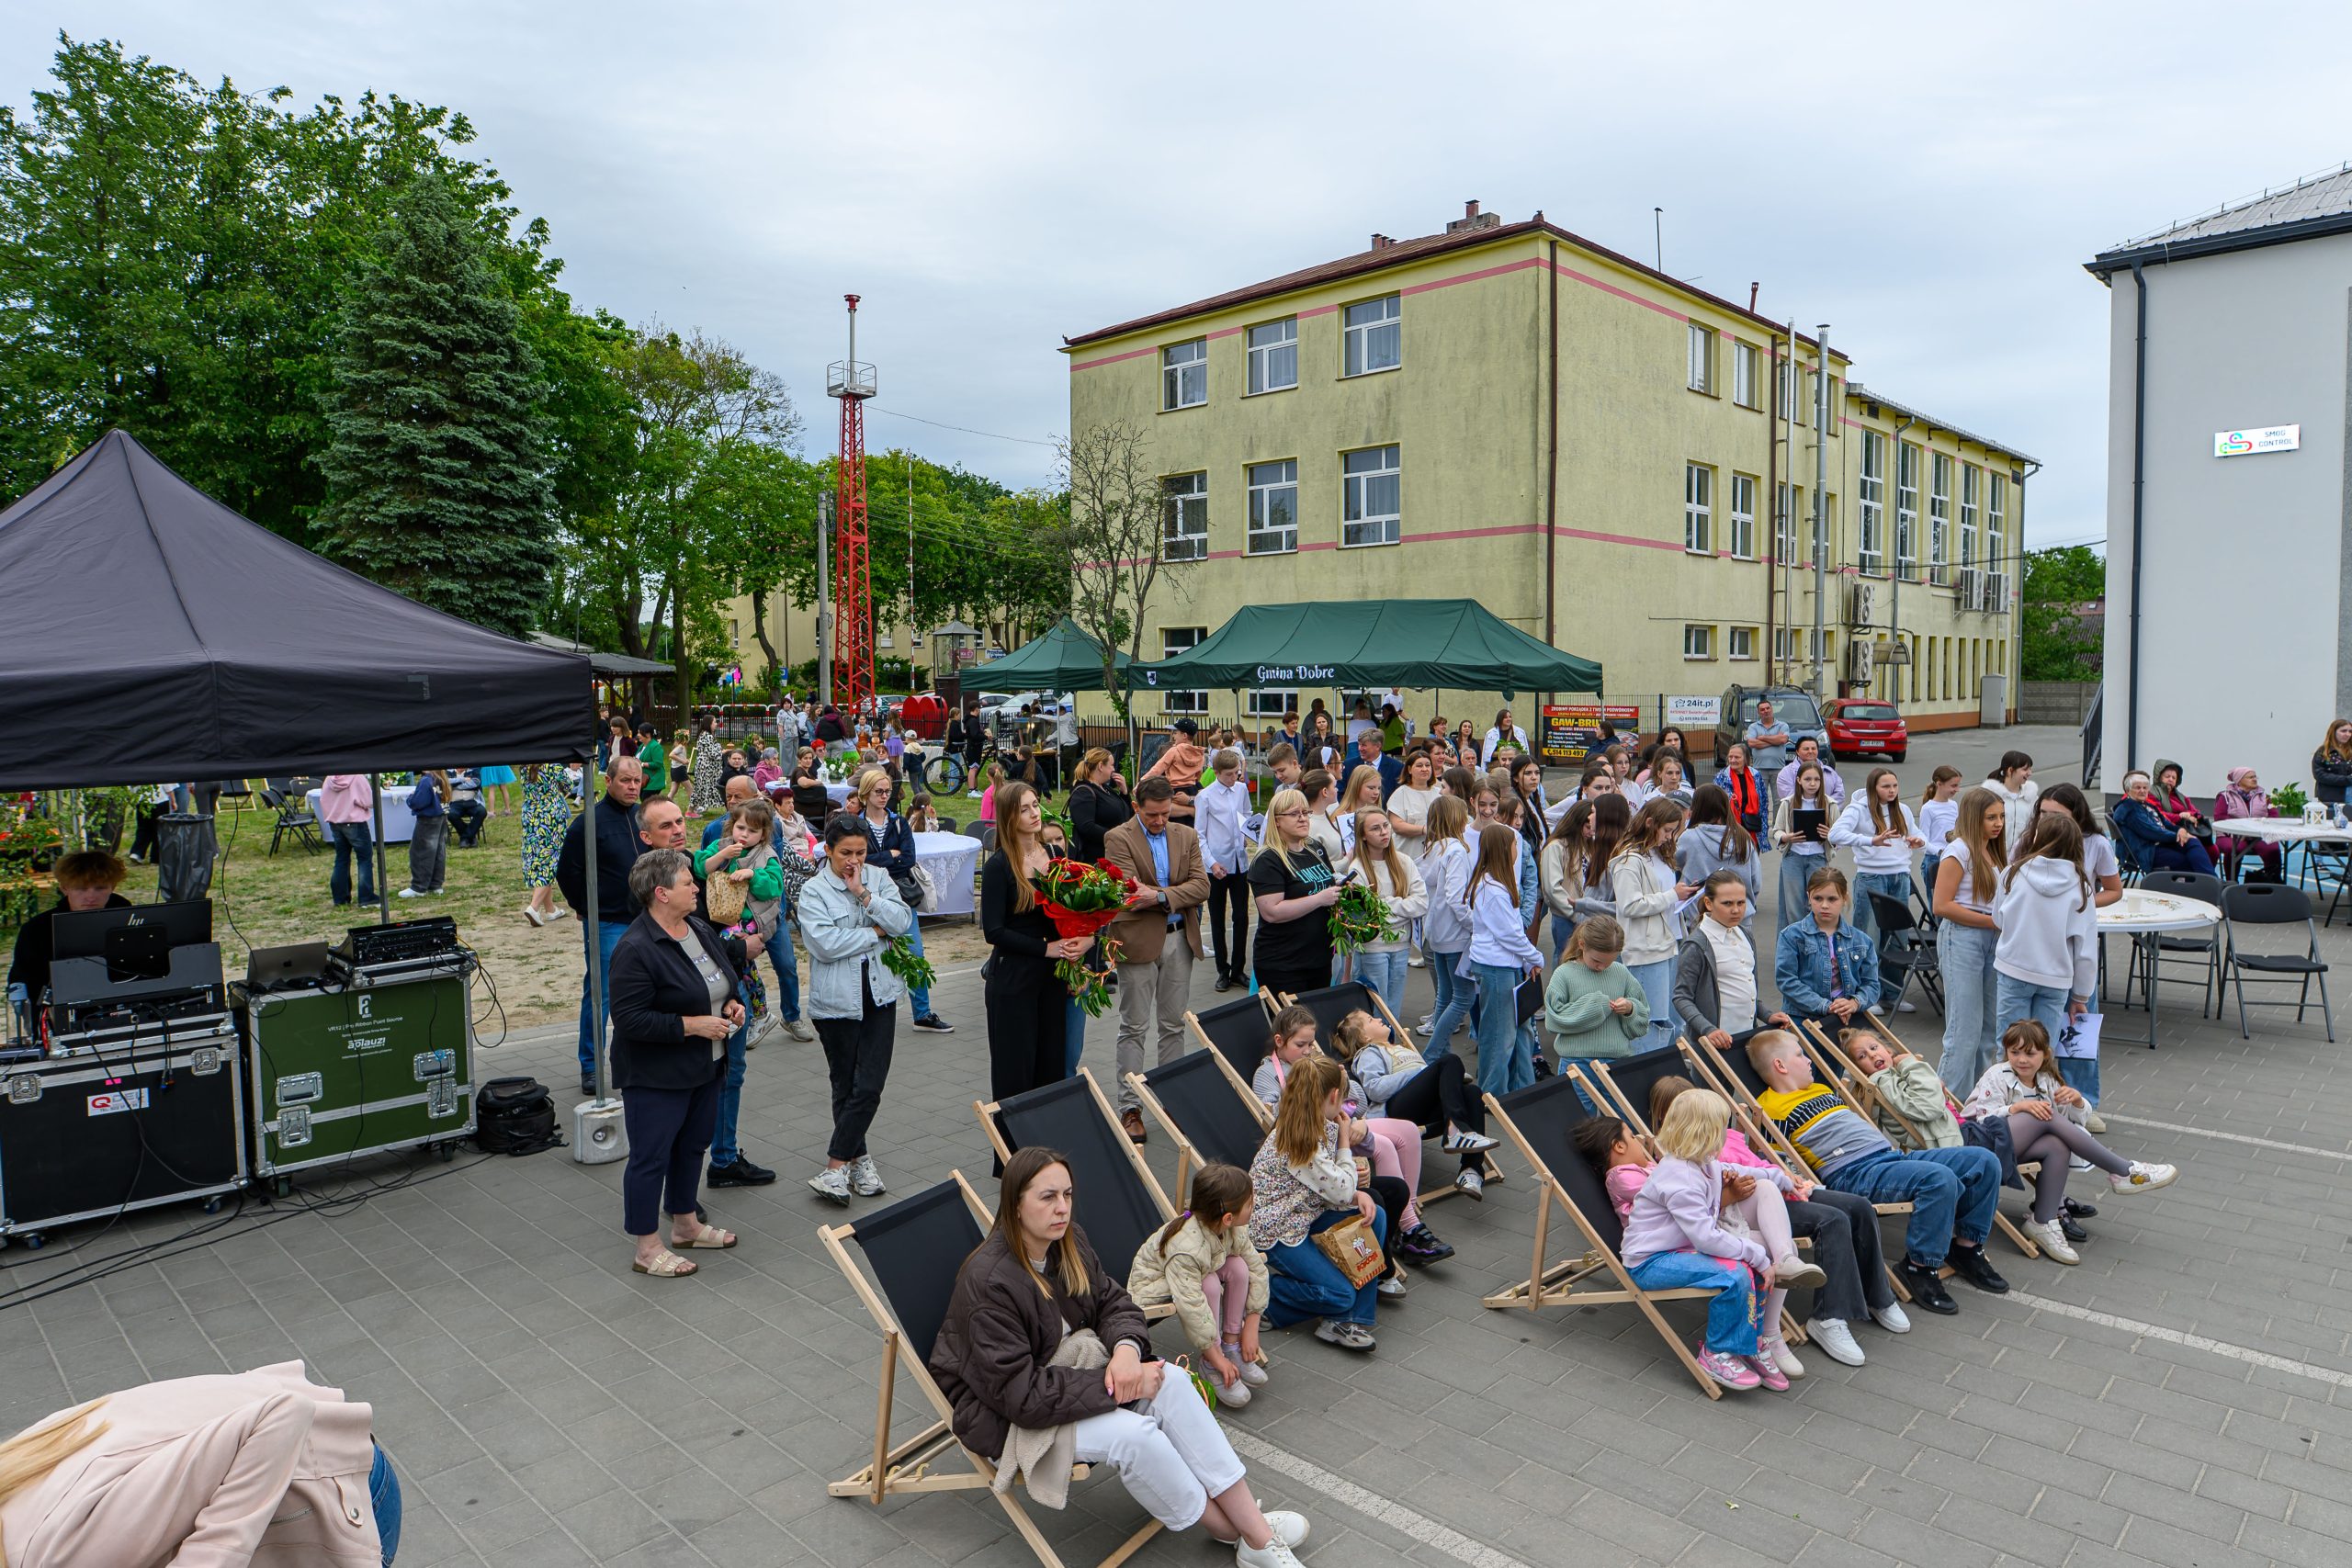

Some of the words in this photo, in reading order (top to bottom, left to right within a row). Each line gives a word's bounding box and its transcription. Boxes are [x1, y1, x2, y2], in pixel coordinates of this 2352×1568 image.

[2265, 429, 2286, 437] SMOG
[2258, 438, 2293, 447] CONTROL
[1257, 665, 1293, 682] Gmina
[1295, 664, 1335, 680] Dobre
[1687, 699, 1713, 708] 24it.pl
[1295, 863, 1334, 884] LIMITE
